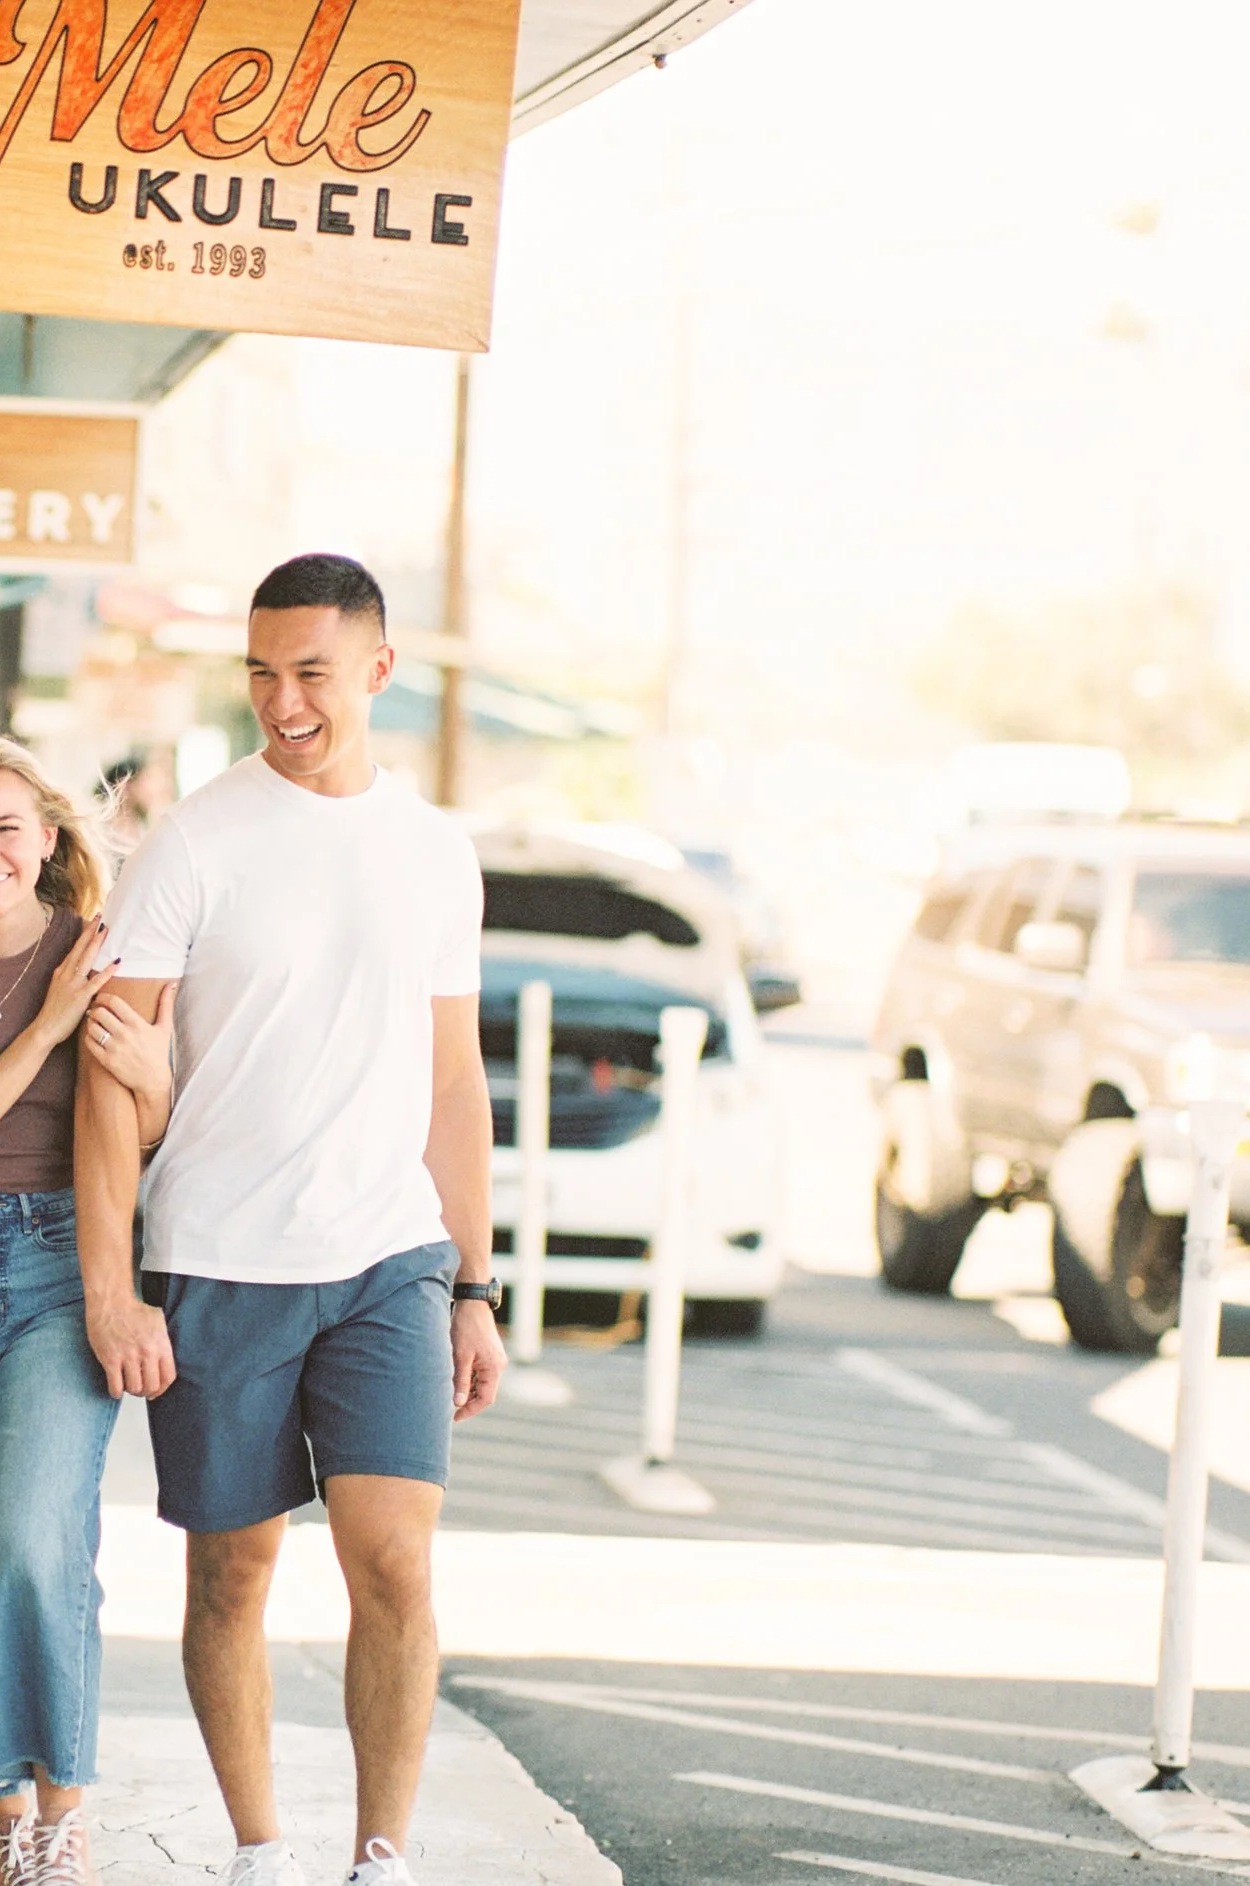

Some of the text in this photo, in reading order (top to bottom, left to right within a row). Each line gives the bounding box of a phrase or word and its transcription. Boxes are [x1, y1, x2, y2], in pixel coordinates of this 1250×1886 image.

[68, 162, 473, 246] UKULELE
[122, 240, 267, 279] est. 1993
